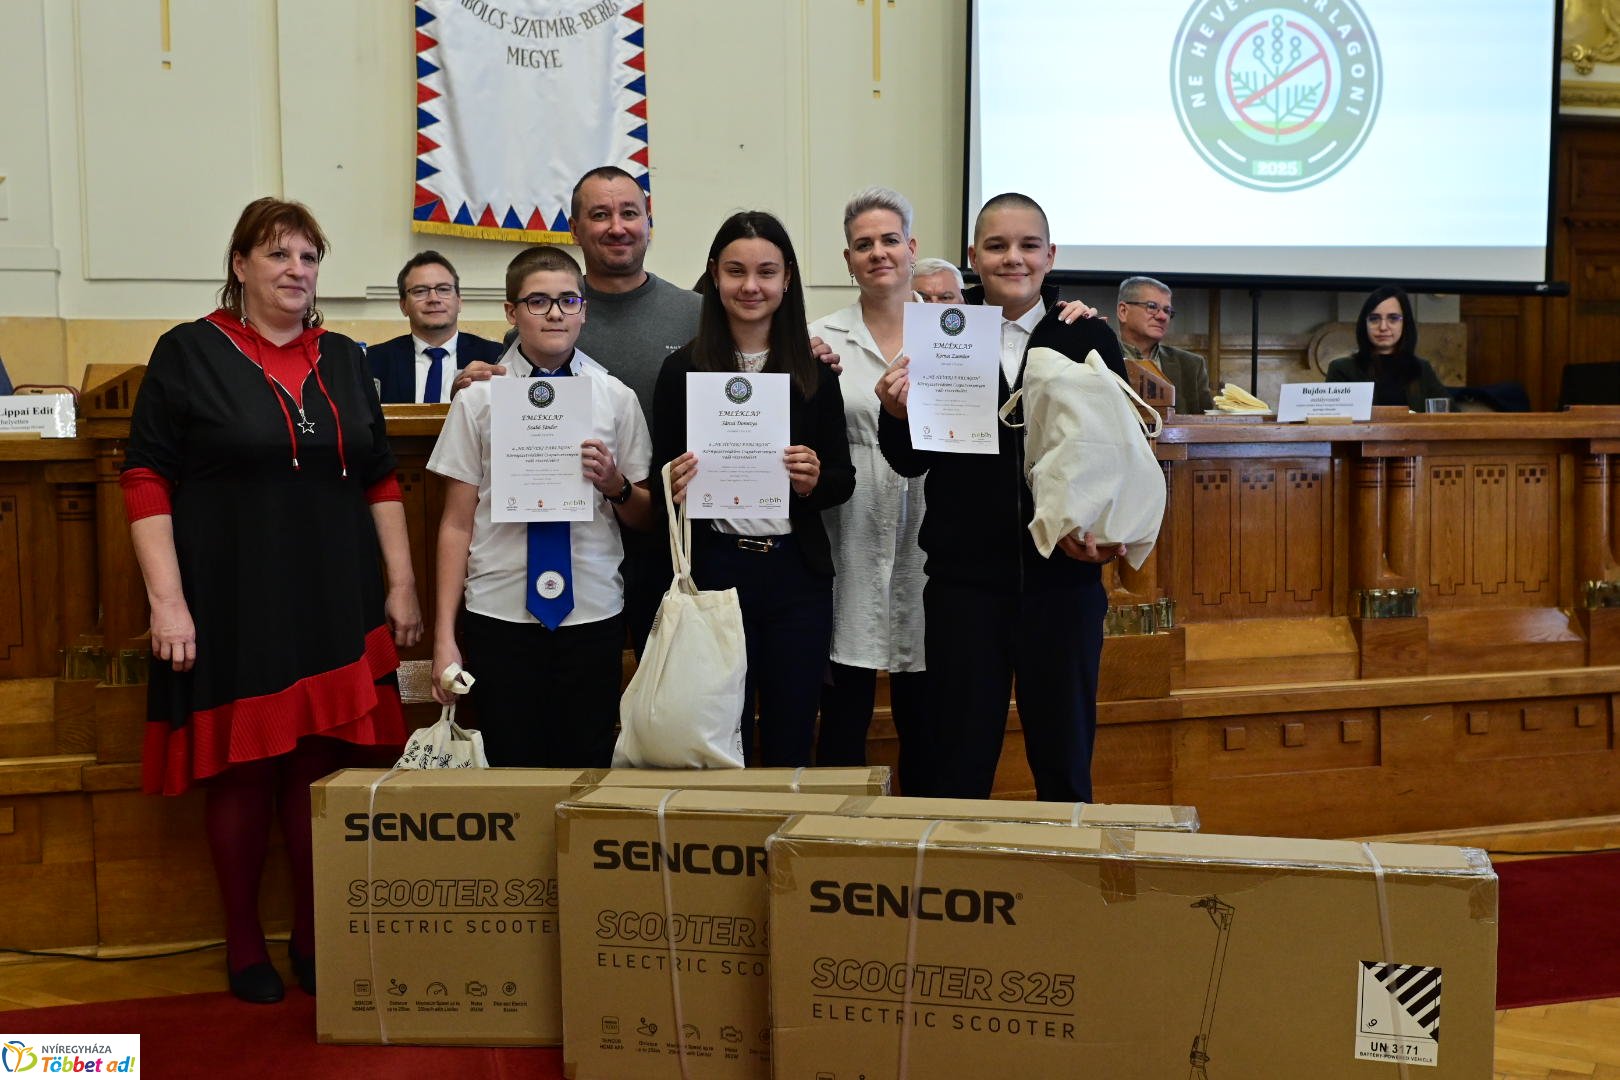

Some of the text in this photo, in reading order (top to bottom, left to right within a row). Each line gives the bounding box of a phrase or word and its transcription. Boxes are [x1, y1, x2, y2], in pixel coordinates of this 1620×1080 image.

[460, 0, 619, 39] BOLCS-SZATMÁR-BEREG
[1191, 0, 1250, 58] HEVE
[506, 46, 562, 69] MEGYE
[1188, 75, 1207, 108] NE
[1257, 162, 1298, 176] 2025
[1302, 387, 1326, 396] Bujdos
[33, 406, 53, 415] Edit
[345, 812, 516, 841] SENCOR
[593, 839, 768, 876] SENCOR
[347, 879, 498, 907] SCOOTER
[810, 880, 1017, 925] SENCOR
[350, 920, 560, 933] ELECTRIC SCOOTE
[596, 910, 757, 947] SCOOTER
[597, 952, 707, 973] ELECTRIC
[811, 957, 1075, 1007] SCOOTER S25
[813, 1003, 1074, 1039] ELECTRIC SCOOTER
[1371, 1041, 1418, 1055] UN 3171
